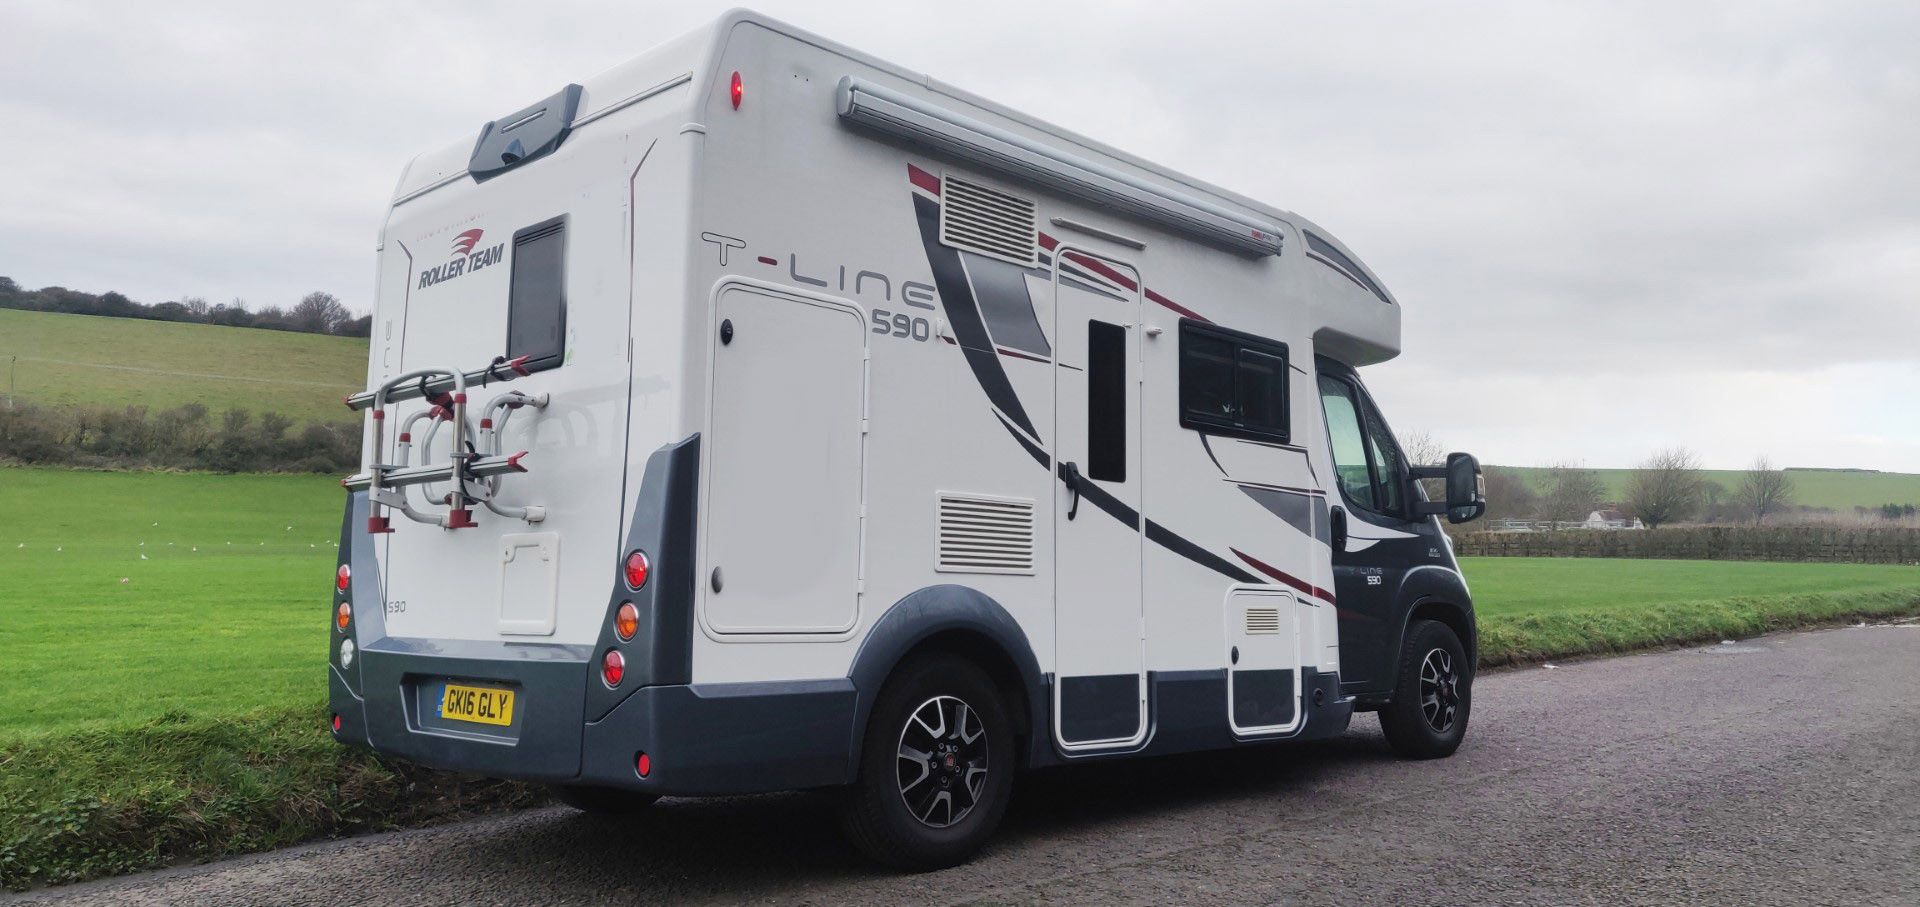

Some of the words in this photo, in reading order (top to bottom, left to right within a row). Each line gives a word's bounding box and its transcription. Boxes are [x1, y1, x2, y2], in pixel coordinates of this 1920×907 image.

[417, 257, 467, 290] ROLLER
[467, 242, 505, 273] TEAM
[871, 308, 930, 342] 590
[1366, 575, 1382, 585] 590
[388, 600, 406, 613] 590
[447, 688, 476, 716] GK16
[477, 691, 508, 720] GLY
